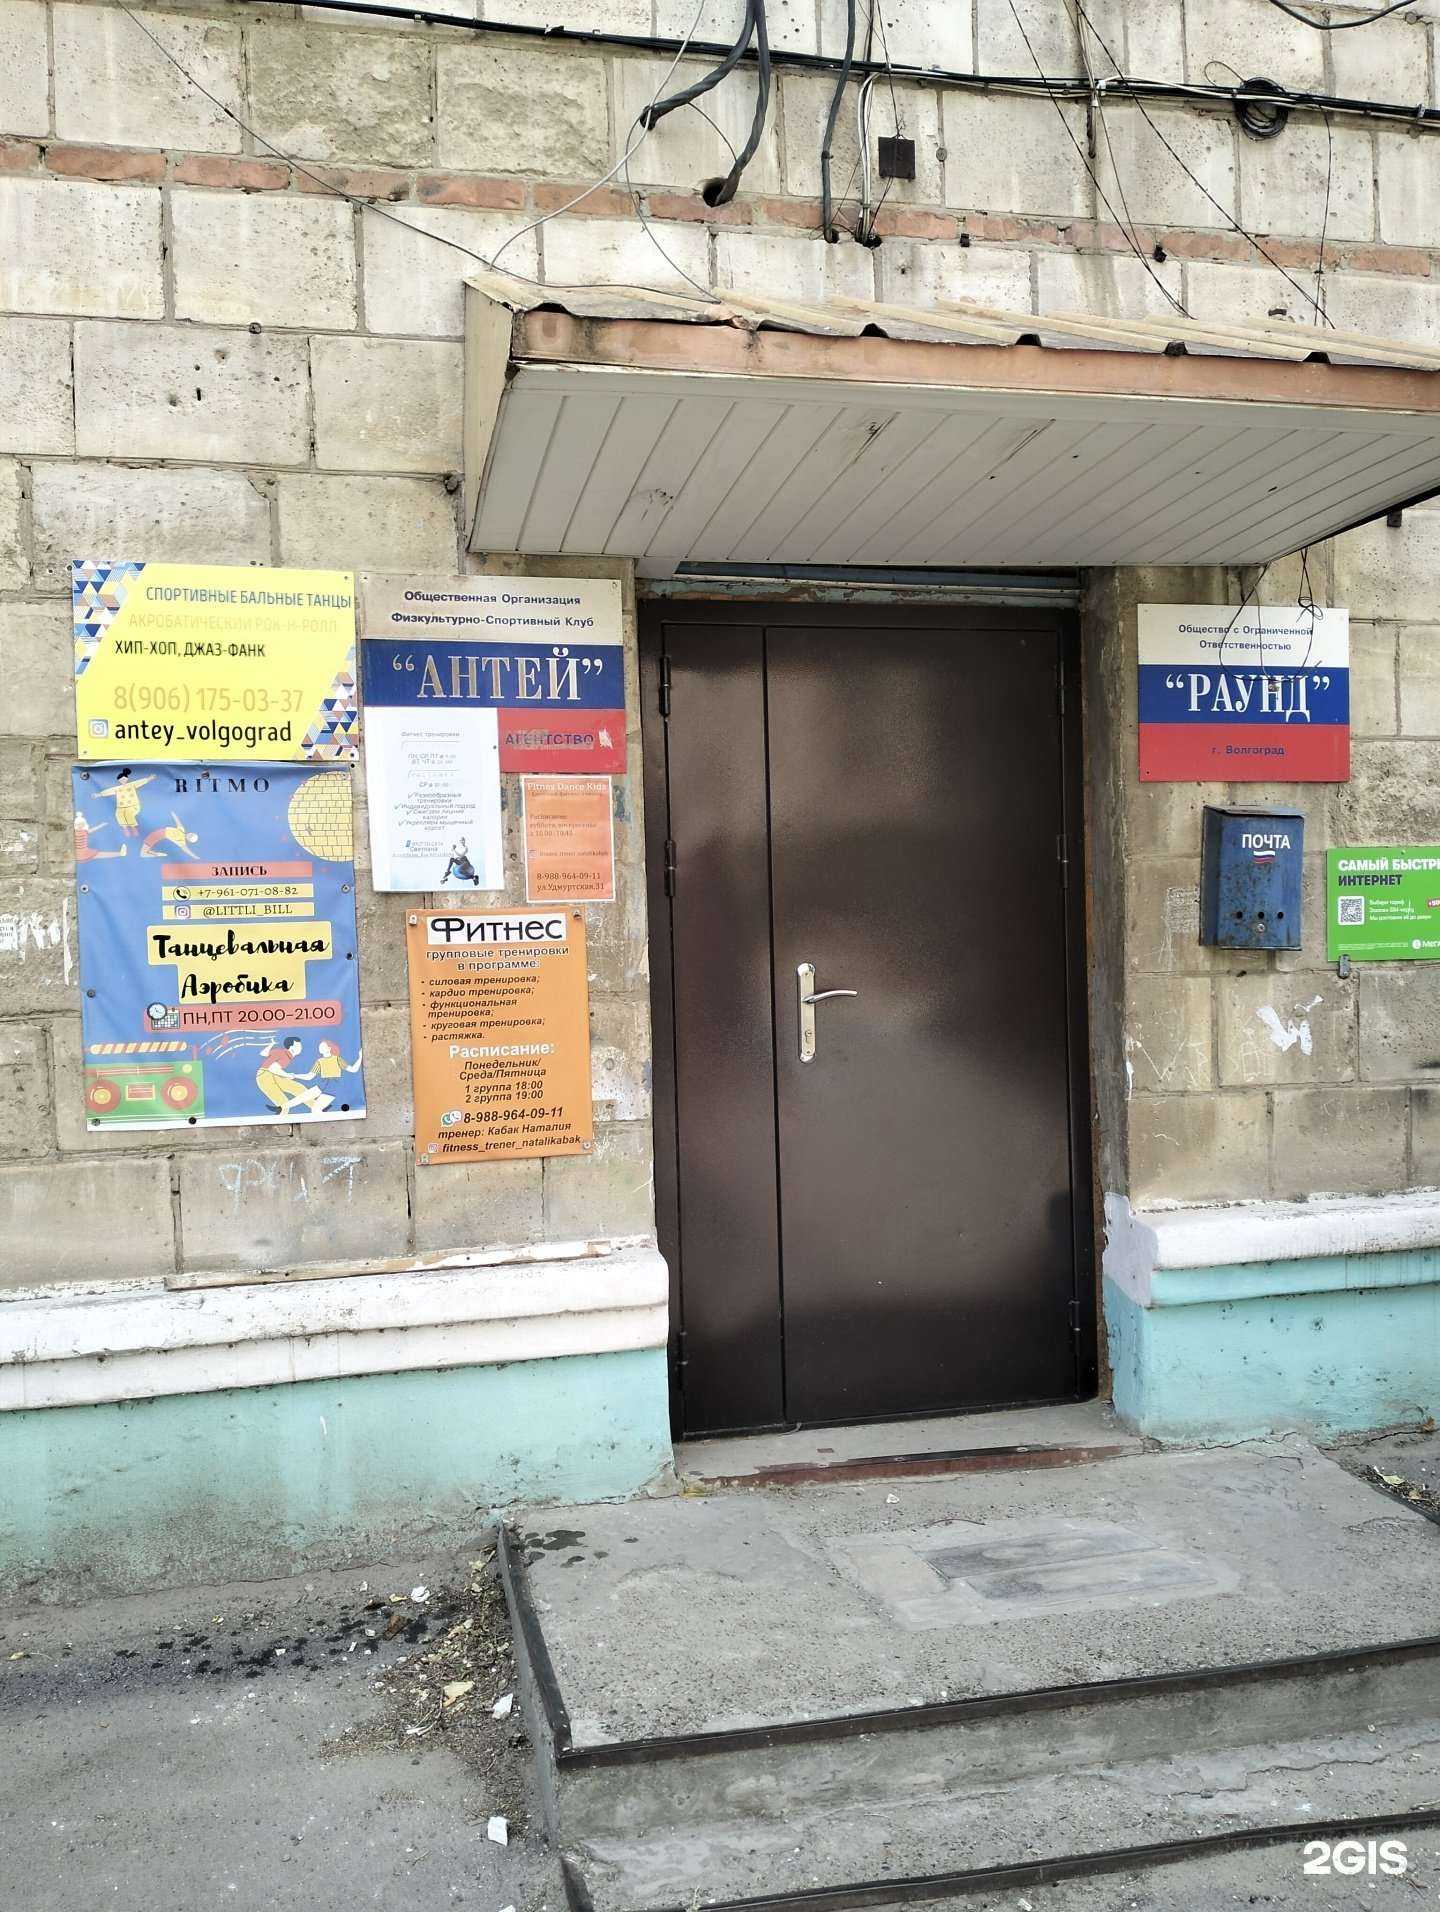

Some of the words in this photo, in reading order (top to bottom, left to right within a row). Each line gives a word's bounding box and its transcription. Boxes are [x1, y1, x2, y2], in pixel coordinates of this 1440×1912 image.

[146, 586, 236, 604] СПОРТИВНЫЕ
[240, 590, 303, 606] БАЛЬНЫЕ
[306, 593, 351, 609] ТАНЦЫ
[404, 590, 497, 604] Общественная
[501, 593, 581, 606] Организация
[128, 613, 251, 632] АКРОБАТИЧЕСКИЙ
[255, 617, 337, 633] РОК-Н-РОЛЛ
[391, 611, 561, 627] Физкультурно-Спортивный
[565, 616, 594, 628] Клуб
[1178, 624, 1230, 635] Общество
[1233, 626, 1239, 634] с
[1243, 625, 1313, 636] Ограниченной
[115, 639, 181, 657] ХИП-ХОП,
[184, 642, 266, 657] ДЖАЗ-ФАНК
[1199, 640, 1292, 651] Ответственностью
[391, 646, 603, 701] “АНТЕЙ”
[114, 682, 189, 713] 8(906)
[199, 687, 304, 713] 175-03-37
[115, 719, 292, 748] antey_volgograd
[505, 728, 594, 746] АГЕНТСТВО
[1212, 747, 1221, 755] г.
[1225, 745, 1286, 756] Волгоград
[175, 777, 270, 793] RITMO
[1241, 834, 1291, 849] ПОЧТА
[211, 865, 267, 877] ЗАПИСЬ
[1338, 857, 1388, 871] САМЫЙ
[1338, 874, 1402, 887] ИНТЕРНЕТ
[197, 887, 298, 898] +7-961-071-08-82
[431, 917, 563, 943] Фитнес
[152, 929, 330, 961] Танцевальная
[427, 949, 494, 961] групповые
[499, 946, 569, 958] тренировки
[469, 960, 540, 971] программе:
[429, 977, 471, 986] силовая
[474, 975, 540, 986] тренировка;
[181, 973, 294, 1004] Аэробика
[429, 988, 466, 998] кардио
[468, 987, 534, 997] тренировка;
[430, 999, 517, 1010] функциональная
[183, 1011, 233, 1026] ПН,ПТ
[238, 1006, 335, 1023] 20.00-21.00
[428, 1010, 494, 1020] тренировка;
[431, 1021, 477, 1030] круговая
[479, 1018, 545, 1029] тренировка;
[431, 1032, 485, 1042] растяжка.
[448, 1043, 555, 1058] Расписание:
[464, 1058, 541, 1070] Понедельник/
[459, 1069, 546, 1081] Среда/Пятница
[465, 1085, 470, 1093] 1
[473, 1084, 512, 1094] группа
[515, 1080, 543, 1090] 18:00
[466, 1094, 472, 1103] 2
[474, 1093, 512, 1104] группа
[516, 1089, 544, 1100] 19:00
[463, 1106, 563, 1124] 8-988-964-09-11
[438, 1128, 485, 1139] тренер:
[488, 1126, 519, 1136] Кабак
[522, 1122, 571, 1133] Наталия
[442, 1135, 582, 1153] fitness_trener_natalikabak
